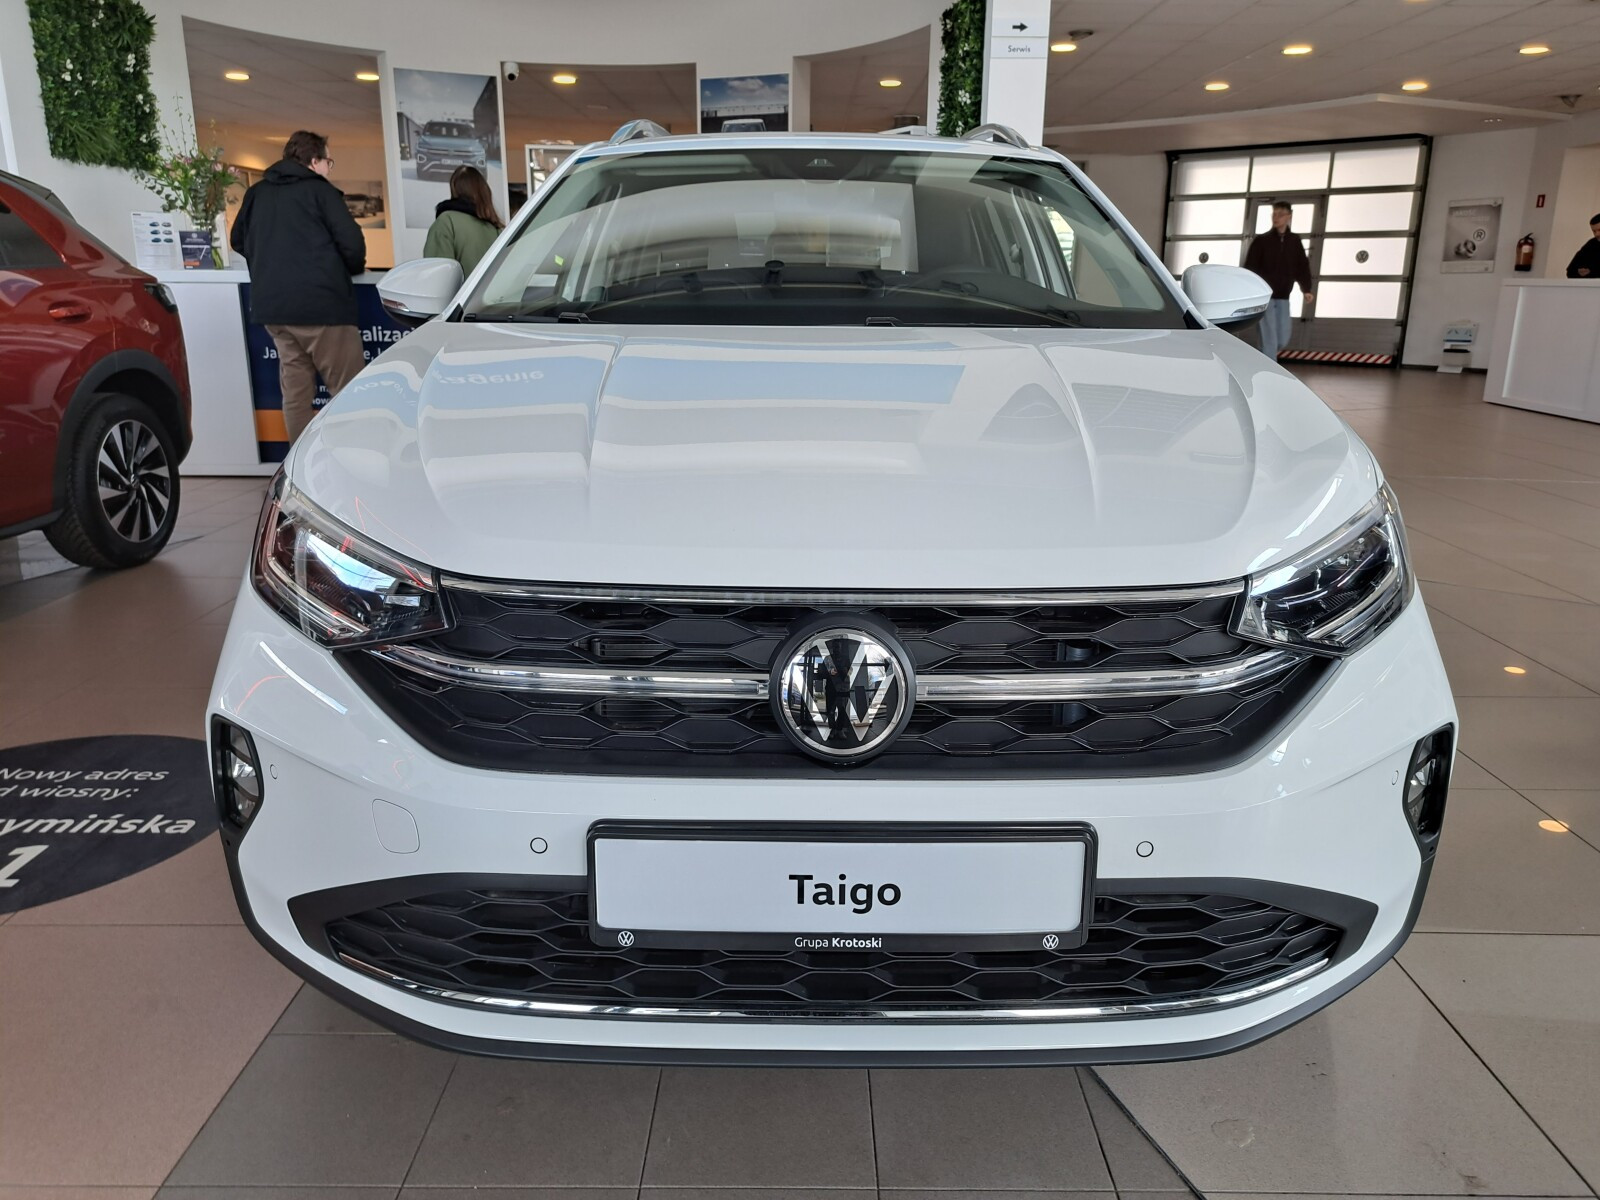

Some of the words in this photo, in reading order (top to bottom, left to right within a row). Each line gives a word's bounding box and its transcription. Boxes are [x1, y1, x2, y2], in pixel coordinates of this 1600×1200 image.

[1007, 44, 1031, 53] Serwis
[0, 768, 82, 783] Nowy
[84, 768, 170, 781] adres
[0, 785, 19, 797] d
[20, 785, 140, 801] wiosny:
[0, 813, 197, 835] ymińska
[788, 873, 902, 915] Taigo
[794, 937, 829, 949] Grupa
[832, 937, 882, 949] Krotoski
